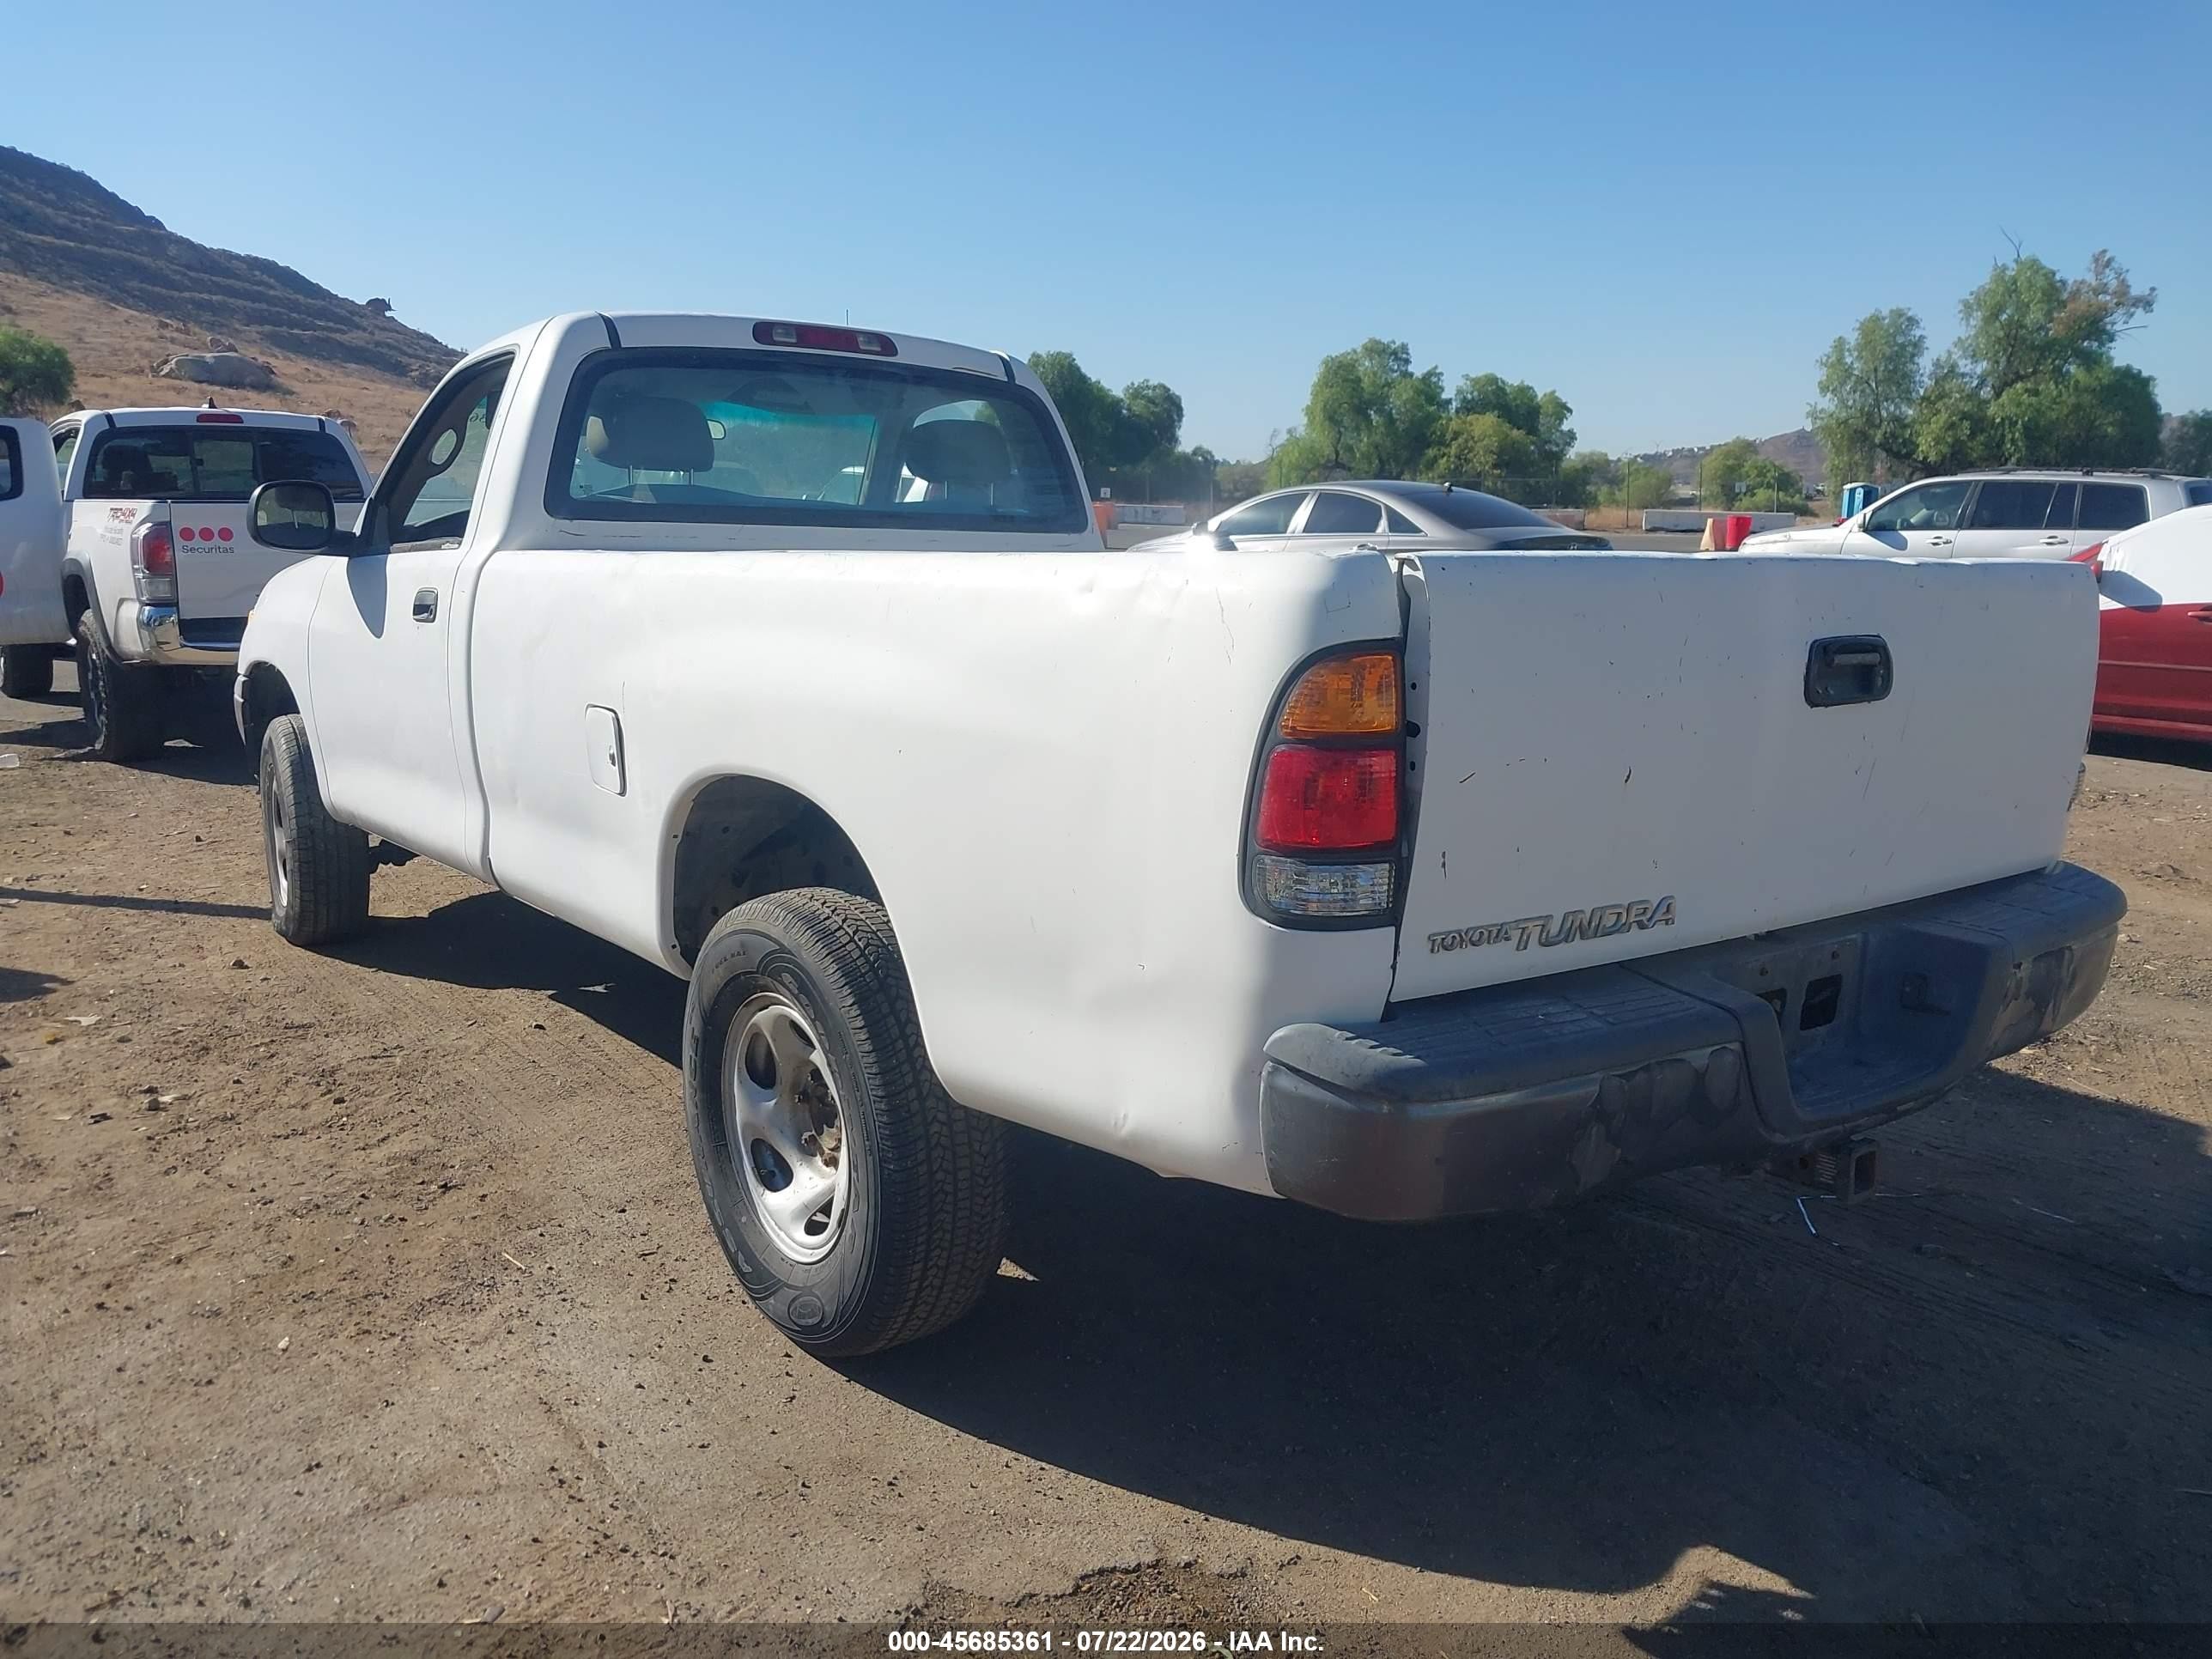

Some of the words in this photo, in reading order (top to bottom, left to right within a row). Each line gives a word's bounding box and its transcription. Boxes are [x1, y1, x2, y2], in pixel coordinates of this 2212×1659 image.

[181, 544, 234, 555] Securitas
[1427, 922, 1512, 954] TOYOTA
[1514, 895, 1676, 952] TUNDRA
